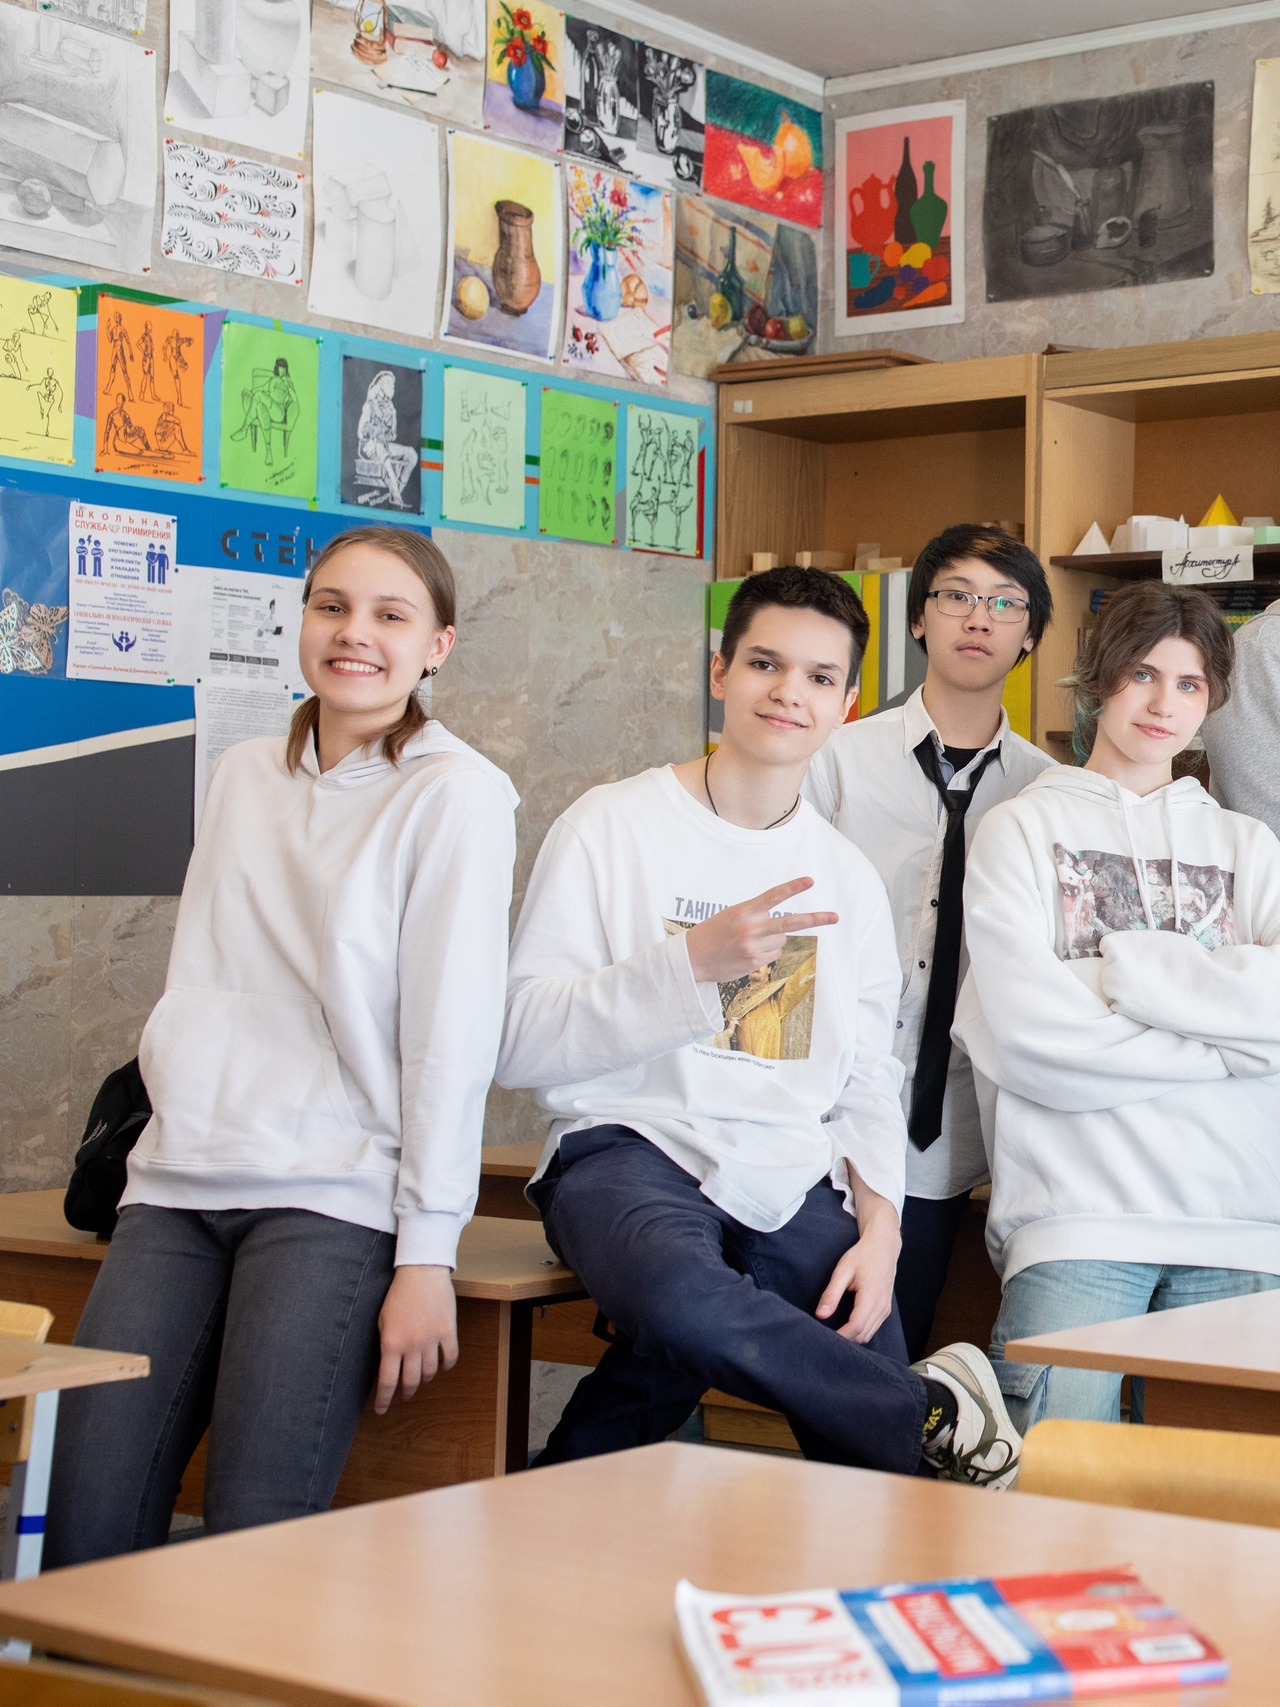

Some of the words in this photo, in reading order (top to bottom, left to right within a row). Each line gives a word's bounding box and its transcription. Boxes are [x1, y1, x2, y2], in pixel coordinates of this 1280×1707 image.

[74, 520, 108, 532] СЛУЖБА
[122, 526, 171, 540] ПРИМИРЕНИЯ
[221, 528, 321, 567] СТЕН
